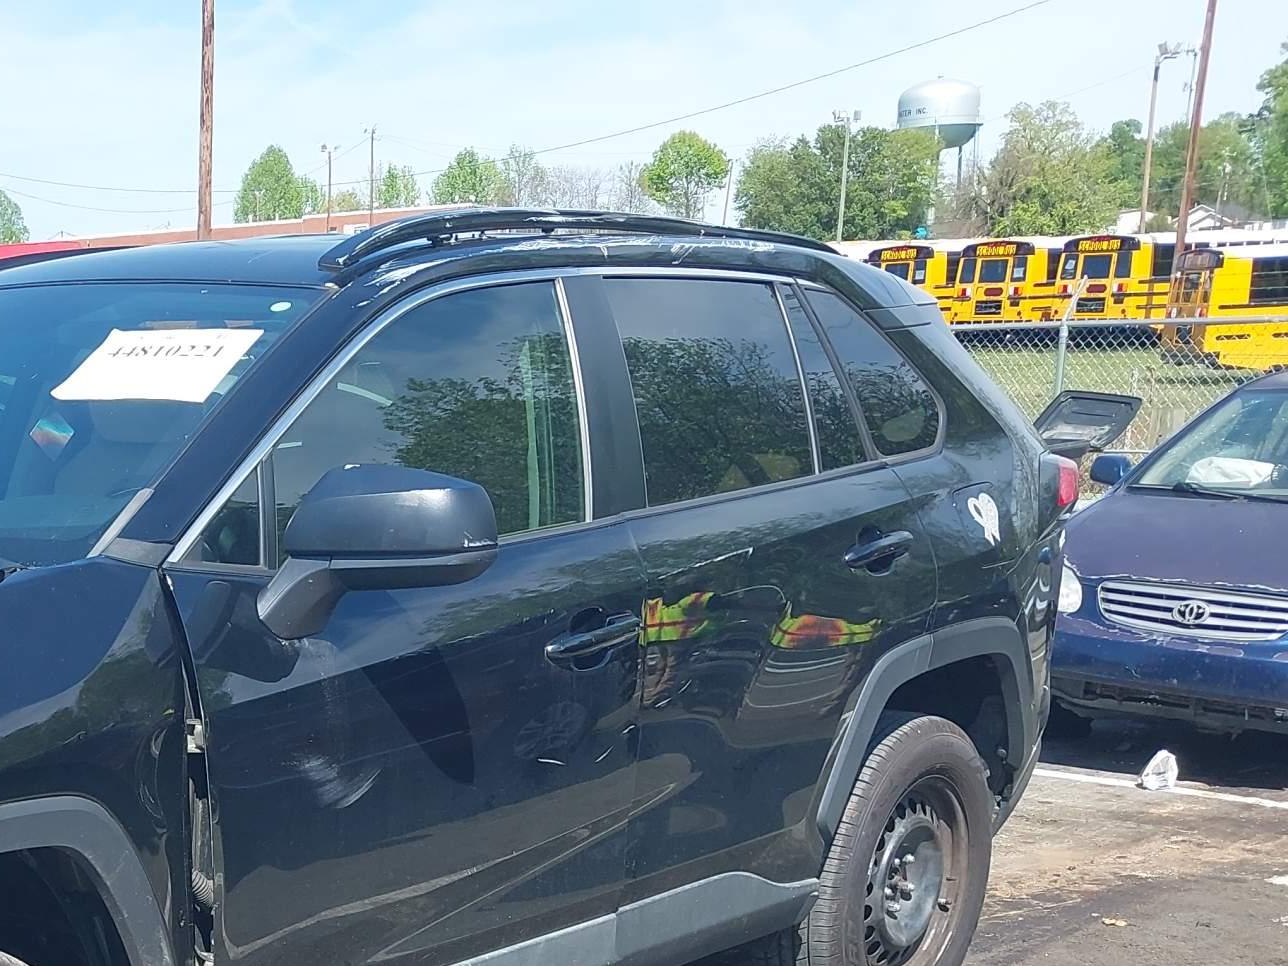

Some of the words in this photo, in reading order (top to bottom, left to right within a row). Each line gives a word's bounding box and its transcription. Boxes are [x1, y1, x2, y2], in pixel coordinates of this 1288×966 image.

[978, 246, 1004, 256] SCHOO
[1079, 240, 1108, 251] SCHOO
[108, 345, 225, 358] 44810221
